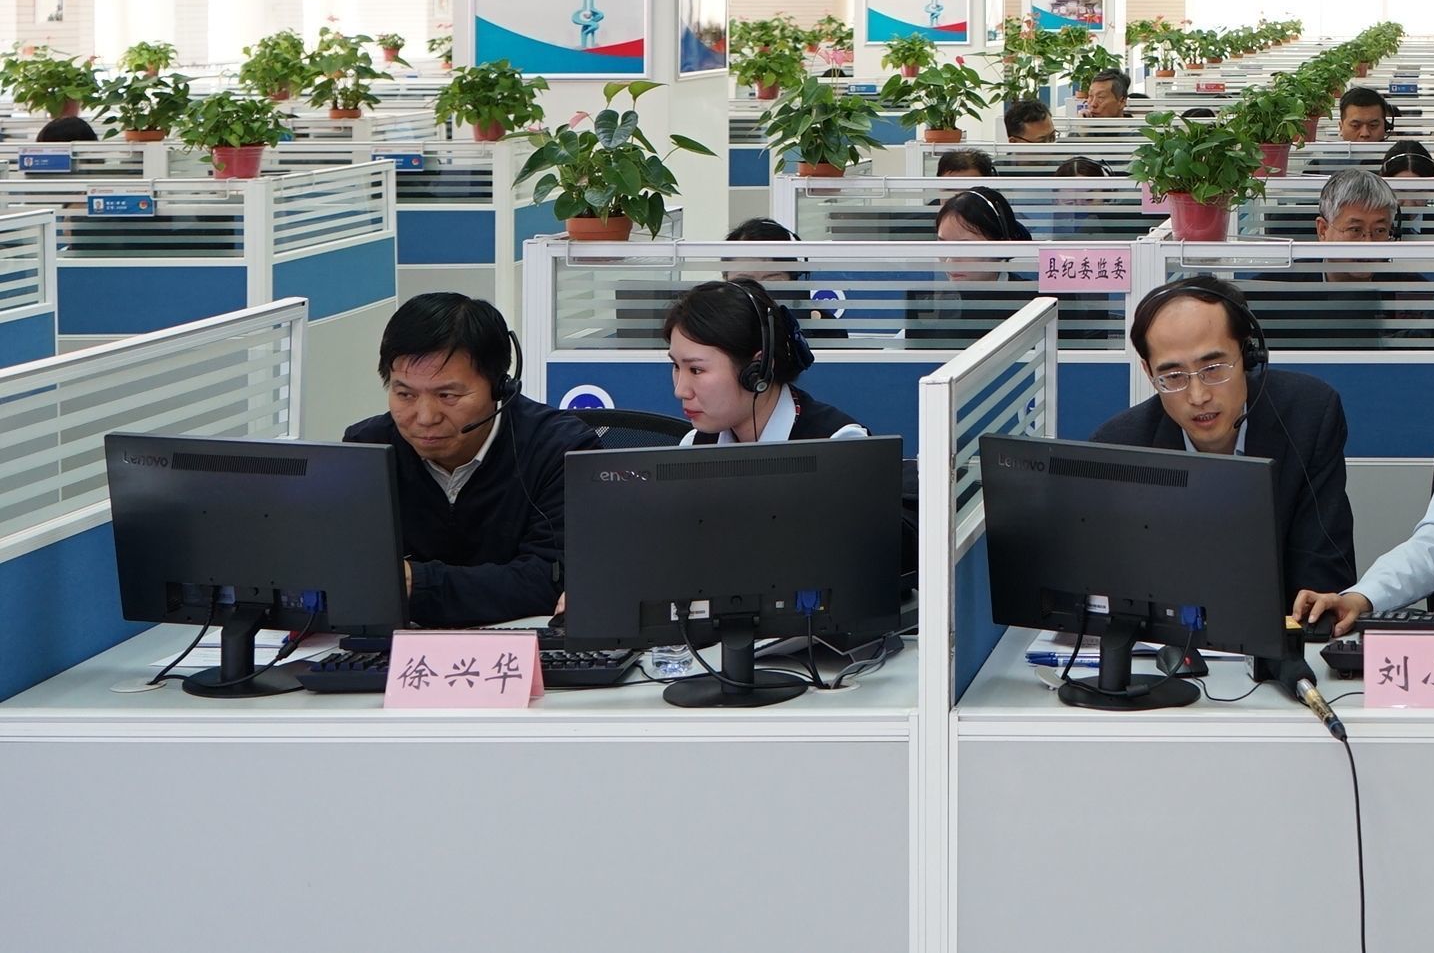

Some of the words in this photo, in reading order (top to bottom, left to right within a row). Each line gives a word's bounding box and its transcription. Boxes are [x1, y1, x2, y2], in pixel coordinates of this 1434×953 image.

[1045, 256, 1127, 280] 县纪委监委
[396, 652, 523, 695] 徐兴华
